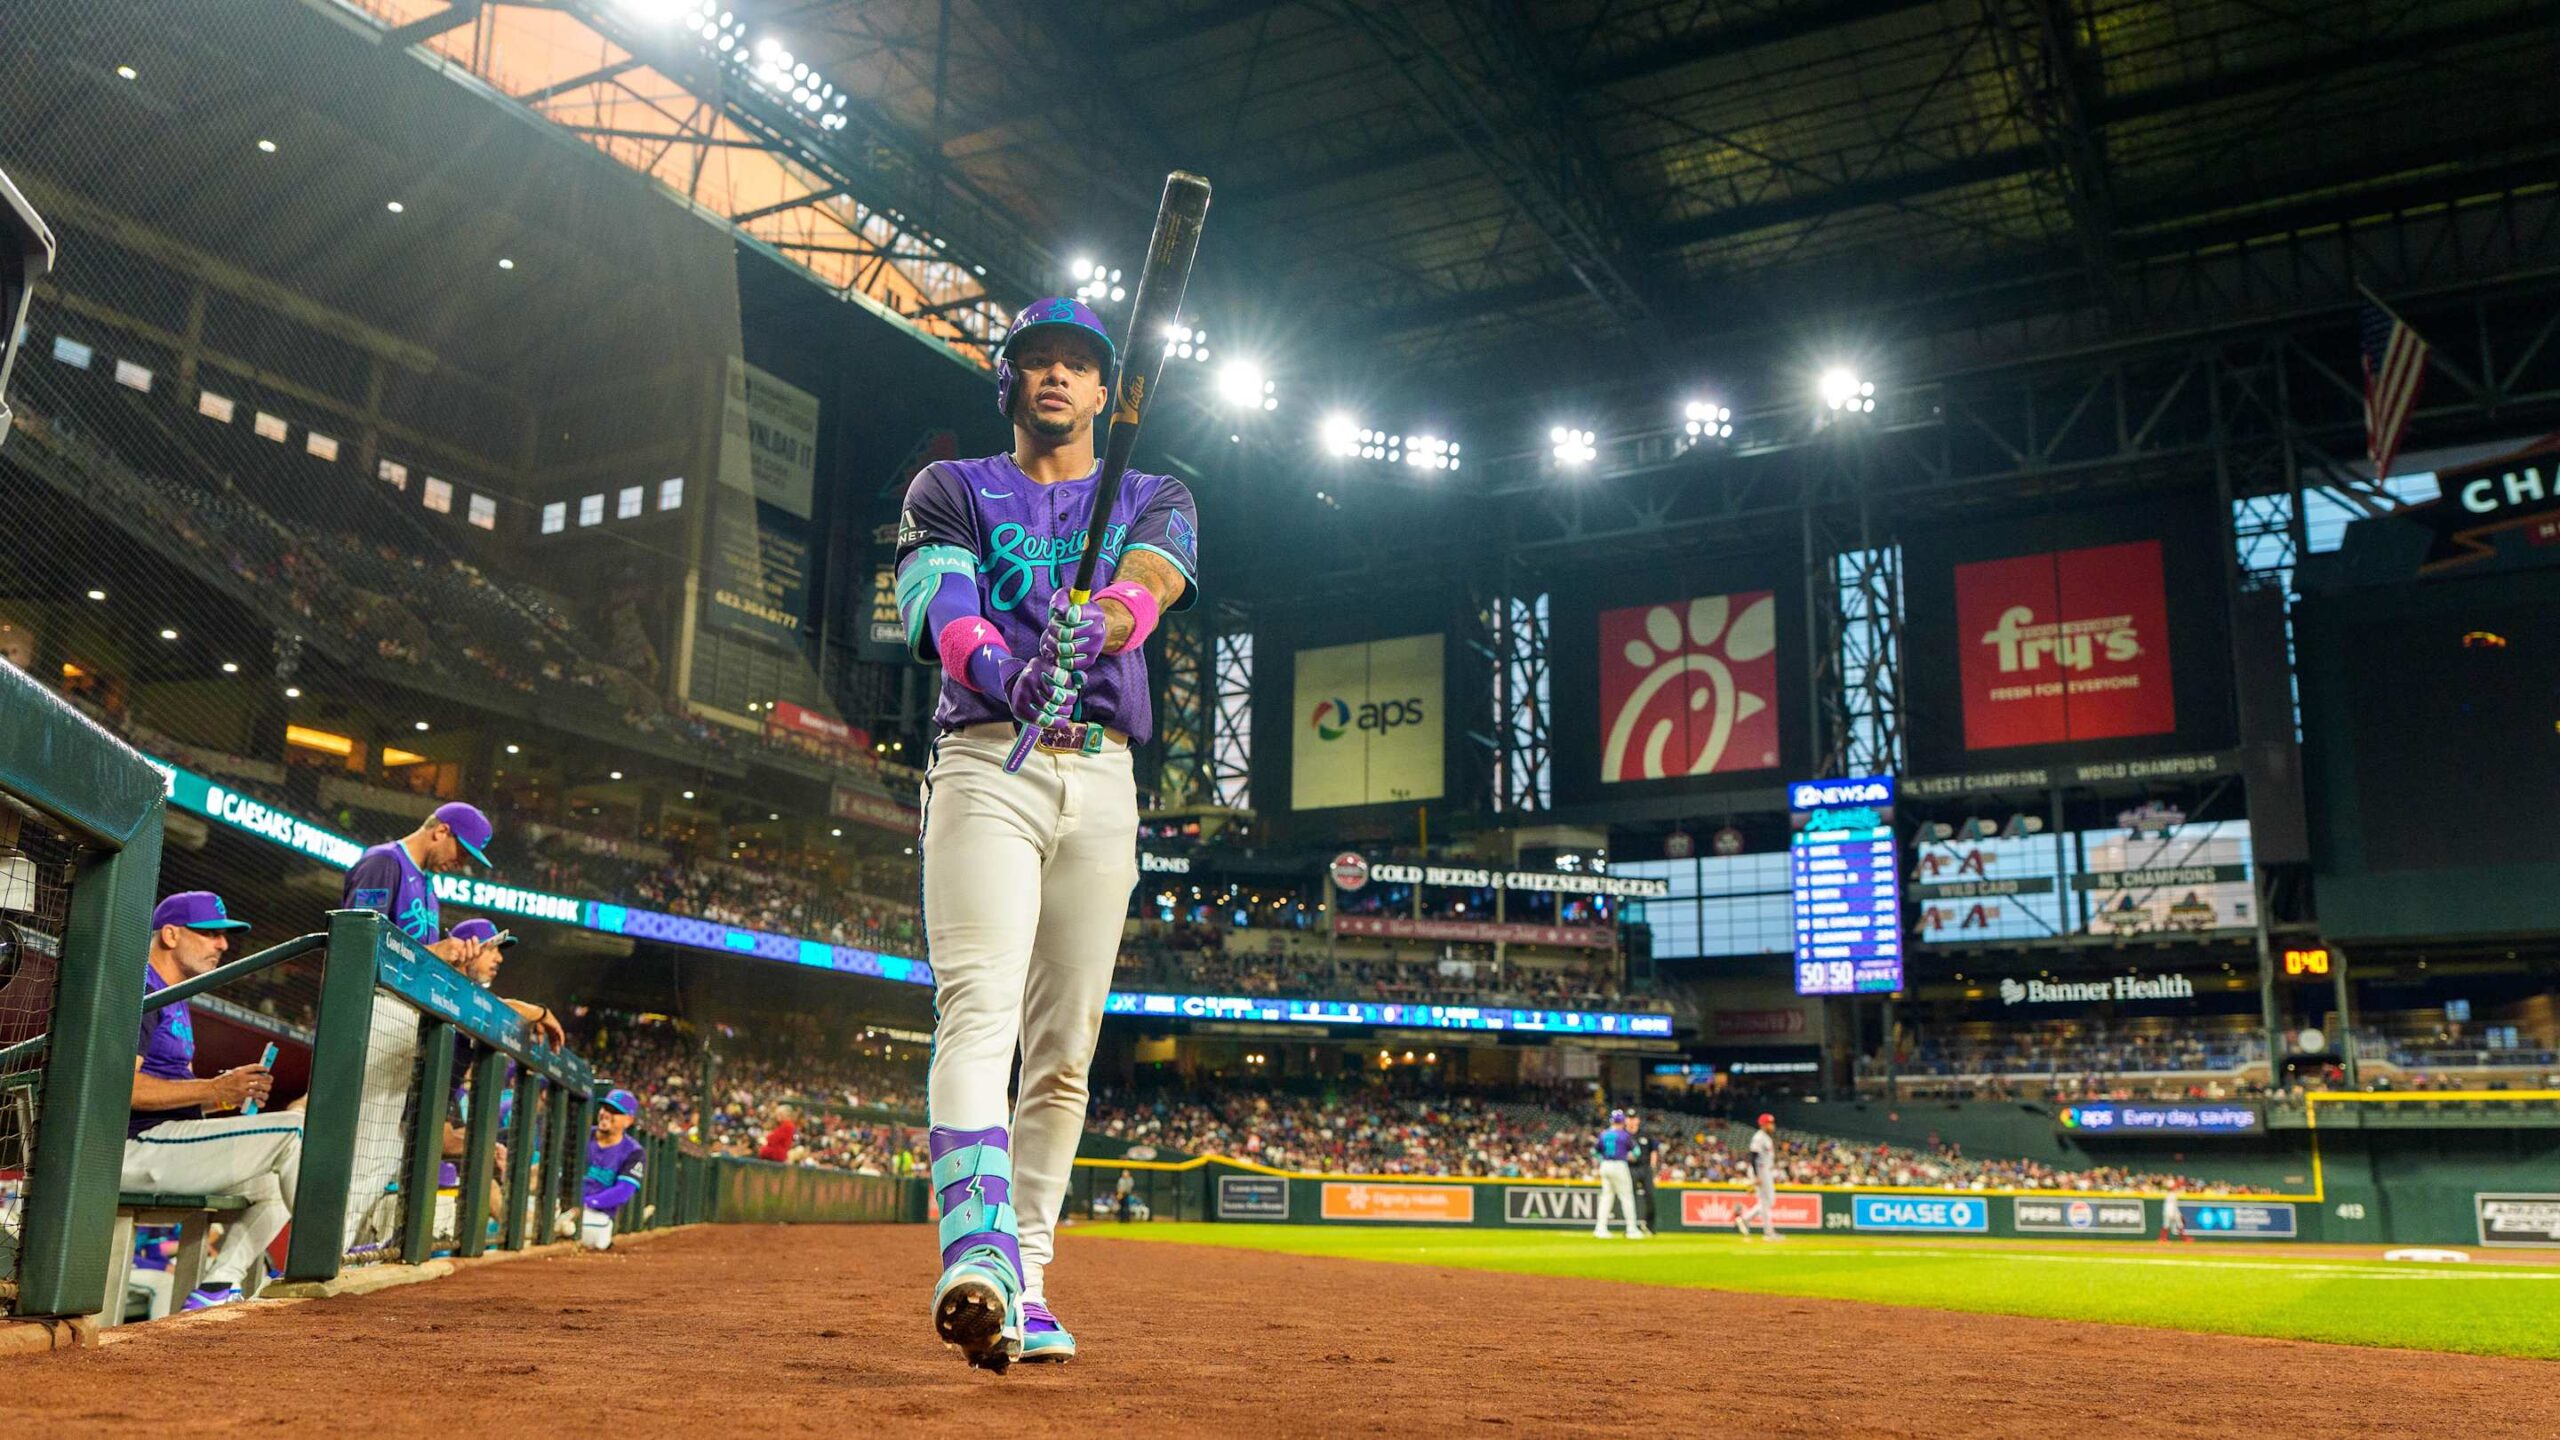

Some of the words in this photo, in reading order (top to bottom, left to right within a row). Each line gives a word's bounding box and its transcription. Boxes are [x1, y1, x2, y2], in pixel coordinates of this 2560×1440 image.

[2461, 462, 2560, 513] CH
[1981, 605, 2139, 672] fry's
[1990, 685, 2033, 701] FRESH
[2035, 682, 2064, 696] FOR
[2067, 674, 2139, 694] EVERYONE
[1357, 698, 1424, 735] aps
[1964, 769, 2049, 791] CHAMPIONS
[2078, 763, 2127, 781] WORLD
[2130, 756, 2217, 778] CHAMPIONS
[223, 794, 292, 843] CAESARS
[1371, 864, 1424, 884] COLD
[1425, 866, 1490, 889] BEERS
[1490, 872, 1504, 889] &
[1506, 872, 1669, 897] CHEESEBURGERS
[1938, 883, 1977, 898] WILD
[1979, 881, 2019, 896] CARD
[2100, 874, 2119, 888] NL
[2122, 867, 2216, 887] CHAMPIONS
[473, 883, 578, 921] SPORTSBOOK
[2027, 979, 2112, 1003] Banner
[2113, 973, 2194, 999] Health
[2080, 1109, 2113, 1129] aps
[2122, 1109, 2166, 1127] Every
[2199, 1108, 2255, 1127] savings
[1522, 1191, 1594, 1219] AVN
[1869, 1202, 1948, 1224] CHASE
[2019, 1206, 2062, 1222] PEPSI
[2100, 1208, 2141, 1224] PEPSI
[1826, 1212, 1851, 1229] 374
